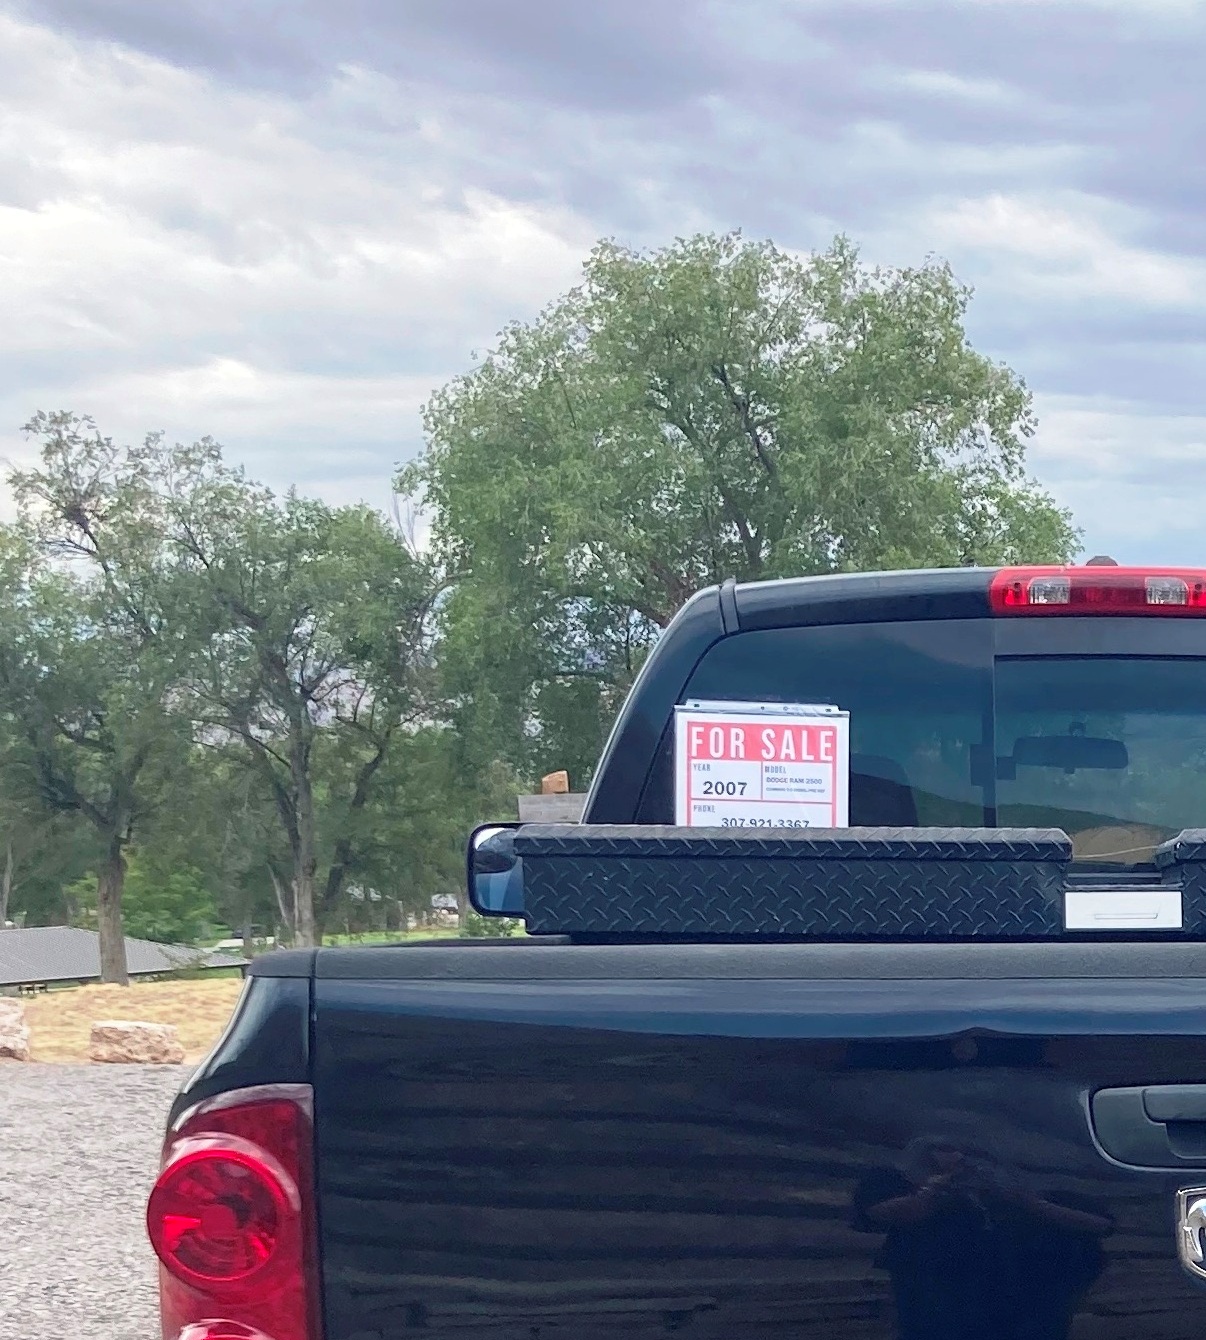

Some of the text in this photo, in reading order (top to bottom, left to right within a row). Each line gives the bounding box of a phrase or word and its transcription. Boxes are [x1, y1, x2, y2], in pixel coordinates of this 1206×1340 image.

[691, 726, 834, 761] FOR SALE
[693, 763, 711, 771] YEAR
[764, 765, 787, 774] MODEL
[766, 776, 788, 784] DODGE
[702, 780, 748, 796] 2007
[693, 804, 716, 813] PHONE
[721, 817, 810, 828] 307-921-3367
